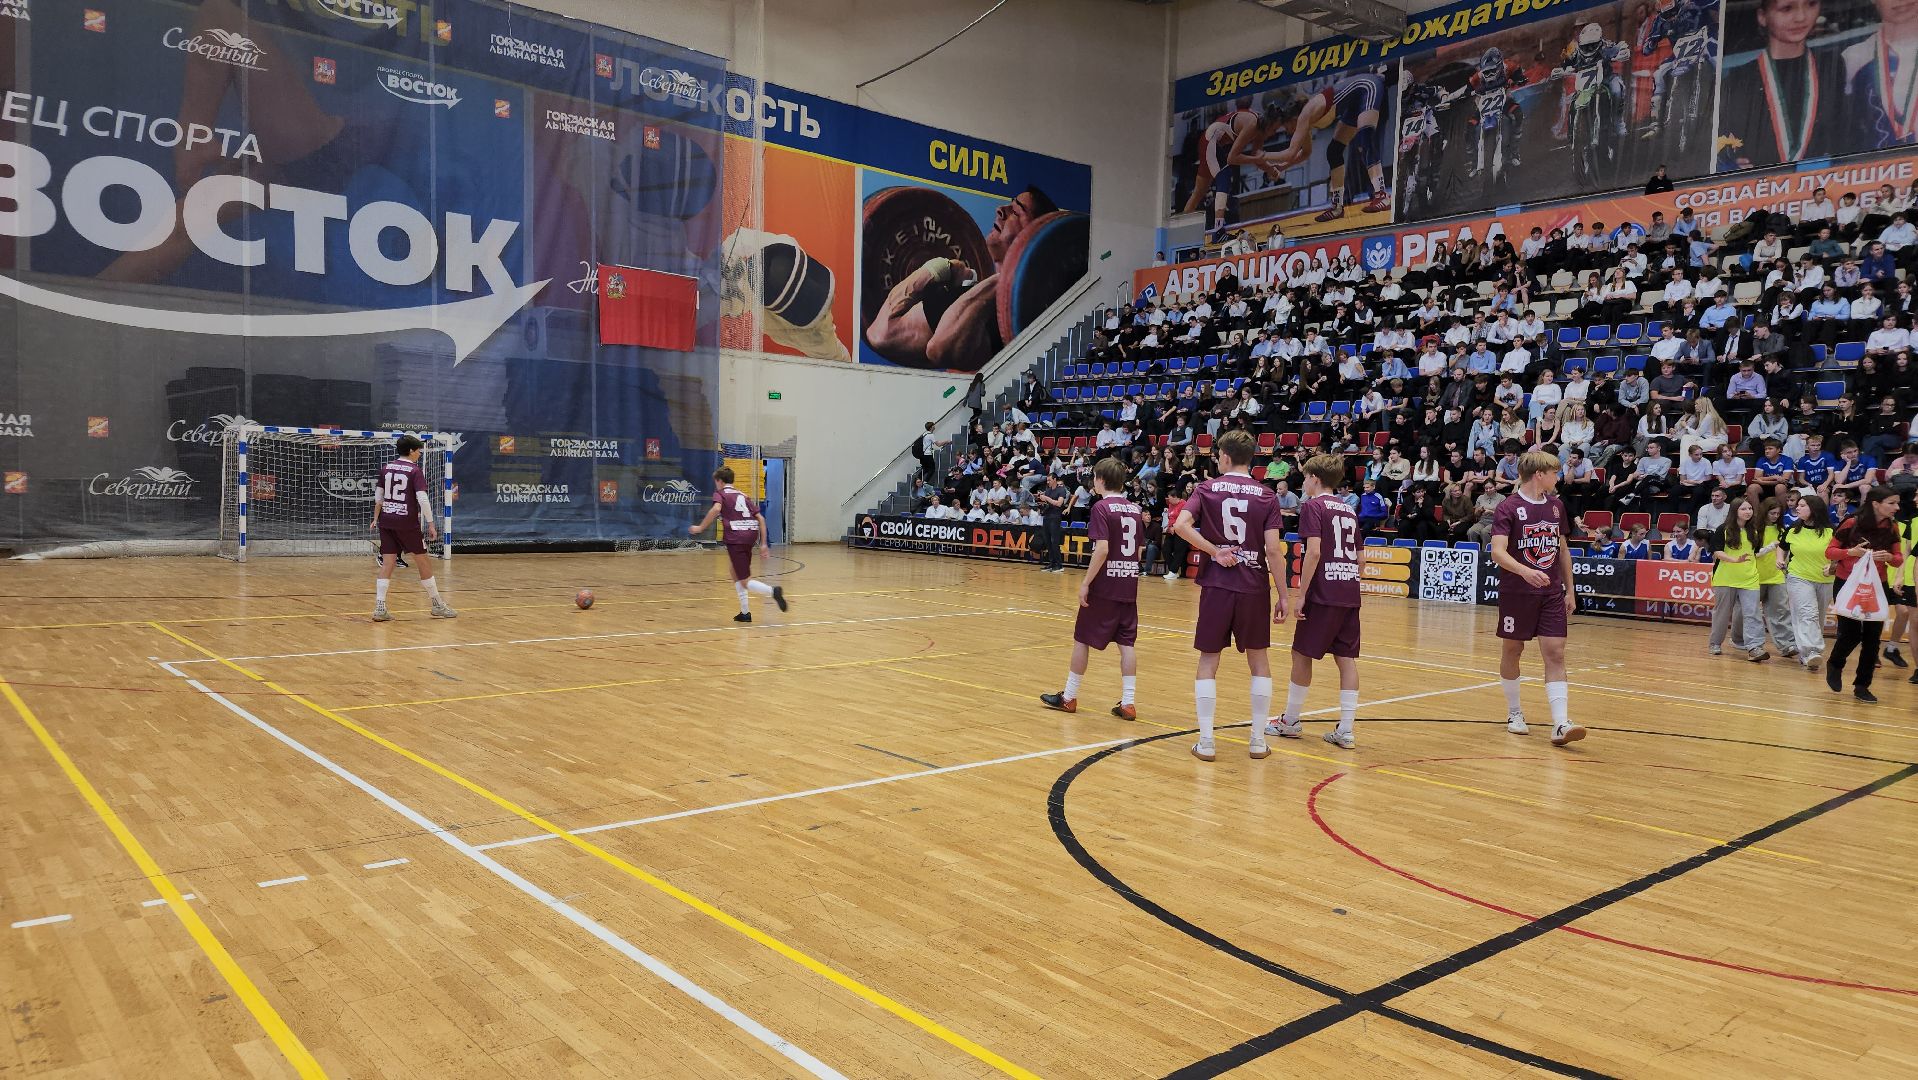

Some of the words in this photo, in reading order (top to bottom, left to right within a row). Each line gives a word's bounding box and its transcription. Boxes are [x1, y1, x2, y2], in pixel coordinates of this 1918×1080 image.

[162, 27, 259, 65] Северный
[539, 55, 566, 69] БАЗА
[387, 74, 459, 100] ВОСТОК
[639, 67, 701, 99] Северный
[1206, 58, 1284, 97] Здесь
[1582, 69, 1597, 90] 7
[1481, 94, 1504, 113] 22
[82, 106, 263, 163] СПОРТА
[592, 129, 617, 141] БАЗА
[929, 139, 1009, 185] СИЛА
[1675, 180, 1791, 211] СОЗДАЁМ
[1797, 162, 1914, 194] ЛУЧШИЕ
[0, 140, 521, 299] ВОСТОК
[594, 450, 620, 459] БАЗА
[89, 472, 192, 500] Северный
[384, 471, 409, 501] 12
[545, 494, 571, 503] БАЗА
[642, 484, 697, 505] Северный
[734, 494, 751, 518] 4
[1516, 506, 1528, 521] 8
[880, 519, 912, 536] СВОЙ
[915, 524, 965, 541] СЕРВИС
[1221, 497, 1249, 545] 6
[1120, 515, 1137, 557] 3
[1331, 514, 1358, 561] 13
[1503, 616, 1515, 633] 8
